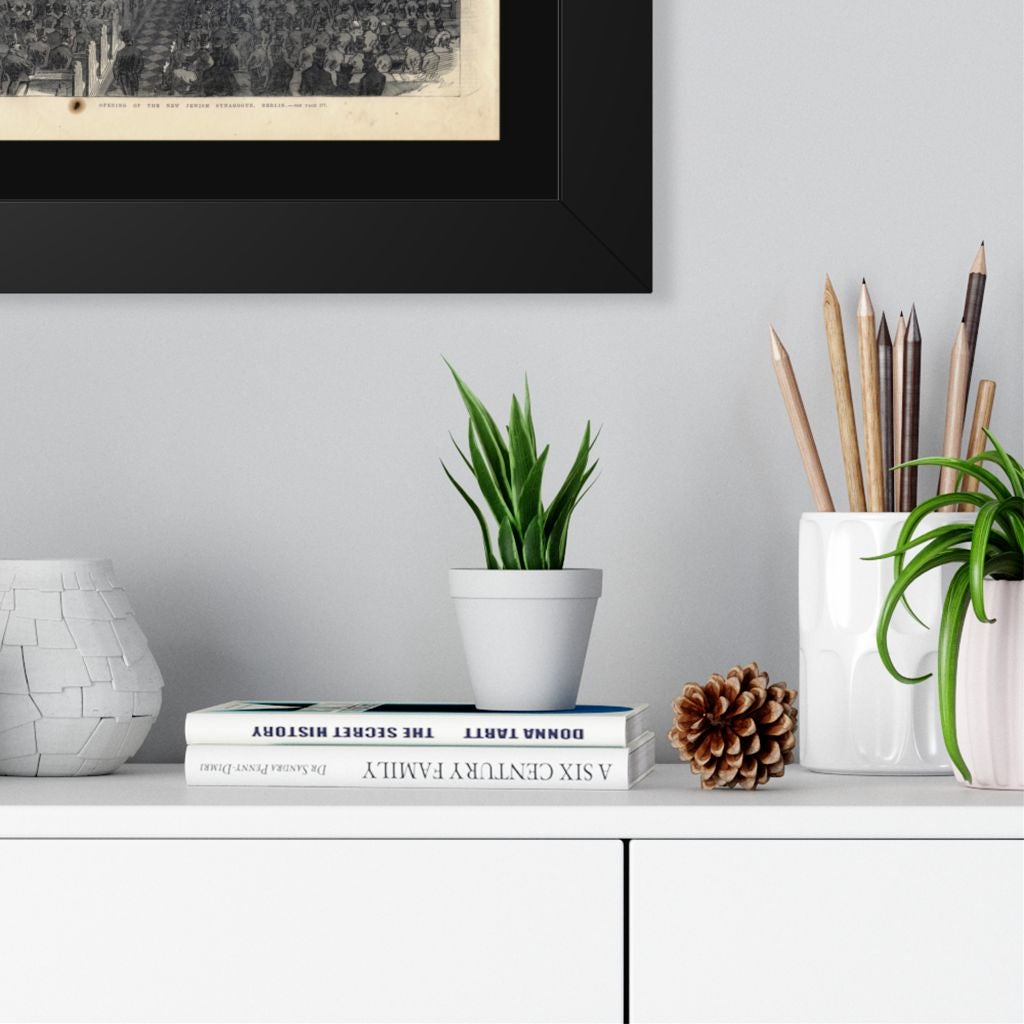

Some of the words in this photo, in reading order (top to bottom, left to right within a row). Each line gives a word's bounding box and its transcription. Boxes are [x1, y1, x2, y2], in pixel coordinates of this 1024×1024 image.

[251, 725, 328, 738] HISTORY
[332, 726, 398, 739] SECRET
[402, 727, 435, 739] THE
[463, 727, 519, 740] TARTT
[522, 727, 585, 741] DONNA
[362, 761, 444, 780] FAMILY
[449, 762, 554, 782] CENTURY
[559, 762, 593, 782] SIX
[597, 762, 613, 781] A
